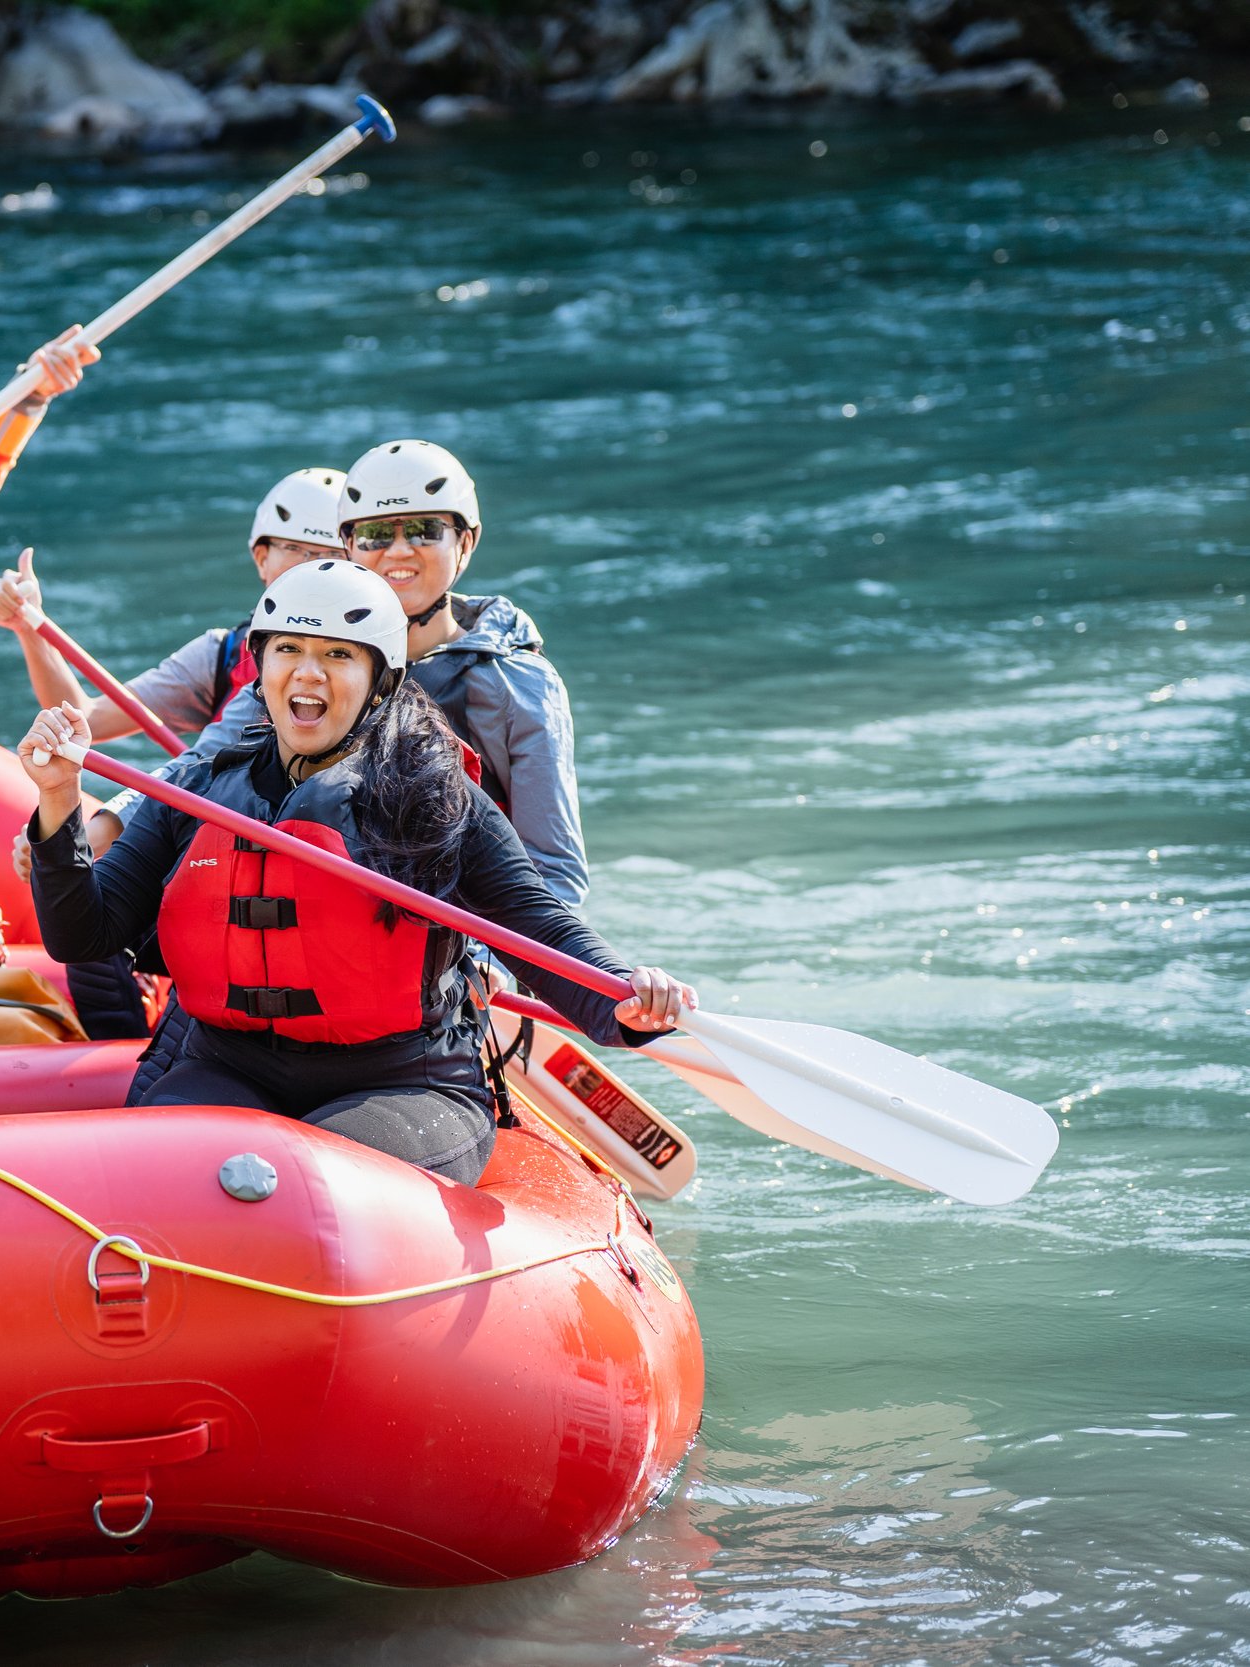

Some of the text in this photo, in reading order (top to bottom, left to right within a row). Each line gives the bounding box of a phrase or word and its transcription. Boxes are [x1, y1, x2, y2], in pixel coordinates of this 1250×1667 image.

[376, 497, 410, 508] NRS
[303, 527, 334, 539] NRS
[286, 616, 322, 627] NRS
[189, 858, 218, 868] NRS
[633, 1246, 676, 1288] NRS
